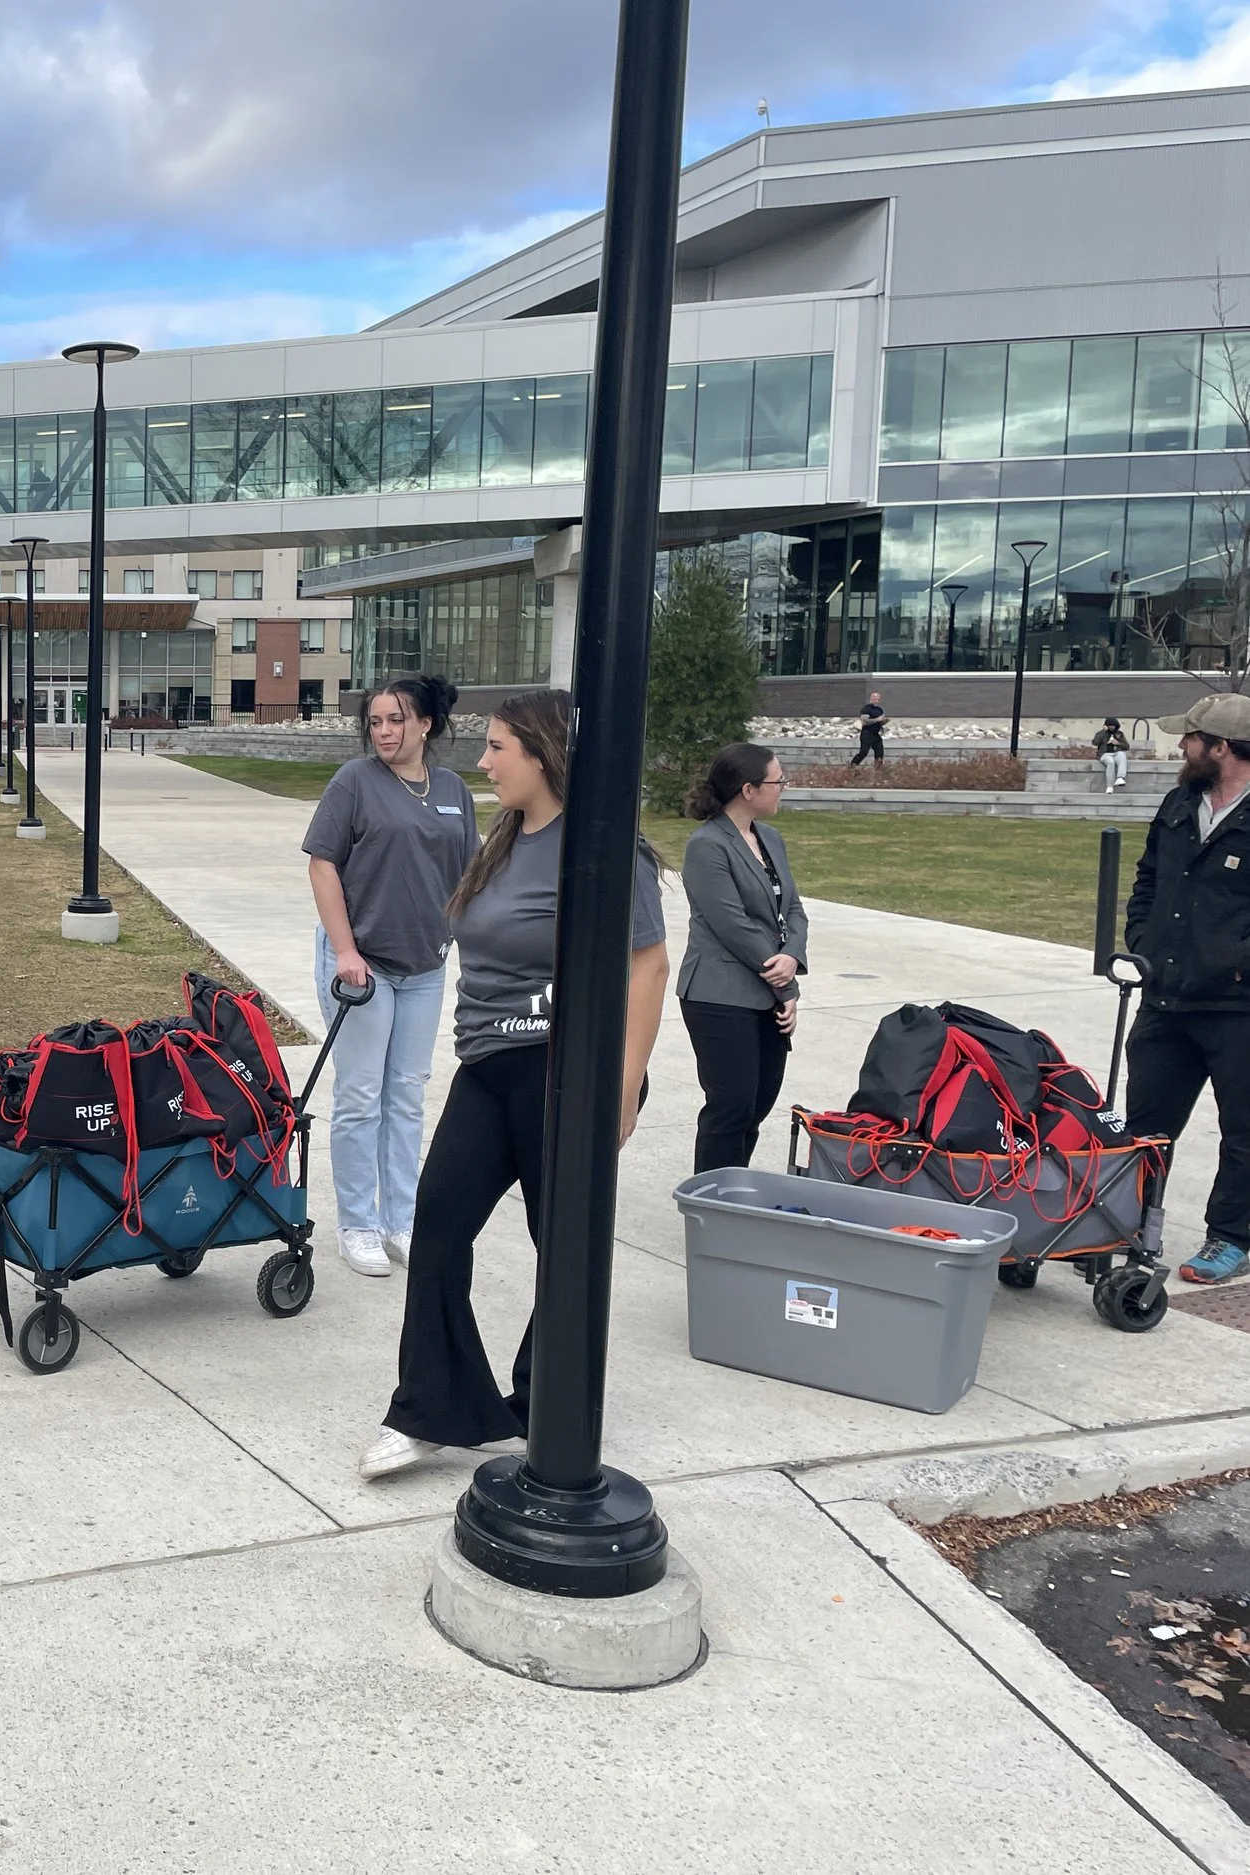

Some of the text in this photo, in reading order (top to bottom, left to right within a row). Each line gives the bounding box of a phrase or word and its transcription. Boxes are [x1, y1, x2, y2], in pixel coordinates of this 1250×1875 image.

[529, 994, 544, 1016] I
[493, 1016, 551, 1034] Harm
[75, 1102, 115, 1119] RISE
[1096, 1110, 1121, 1124] RISE
[86, 1117, 111, 1132] UP
